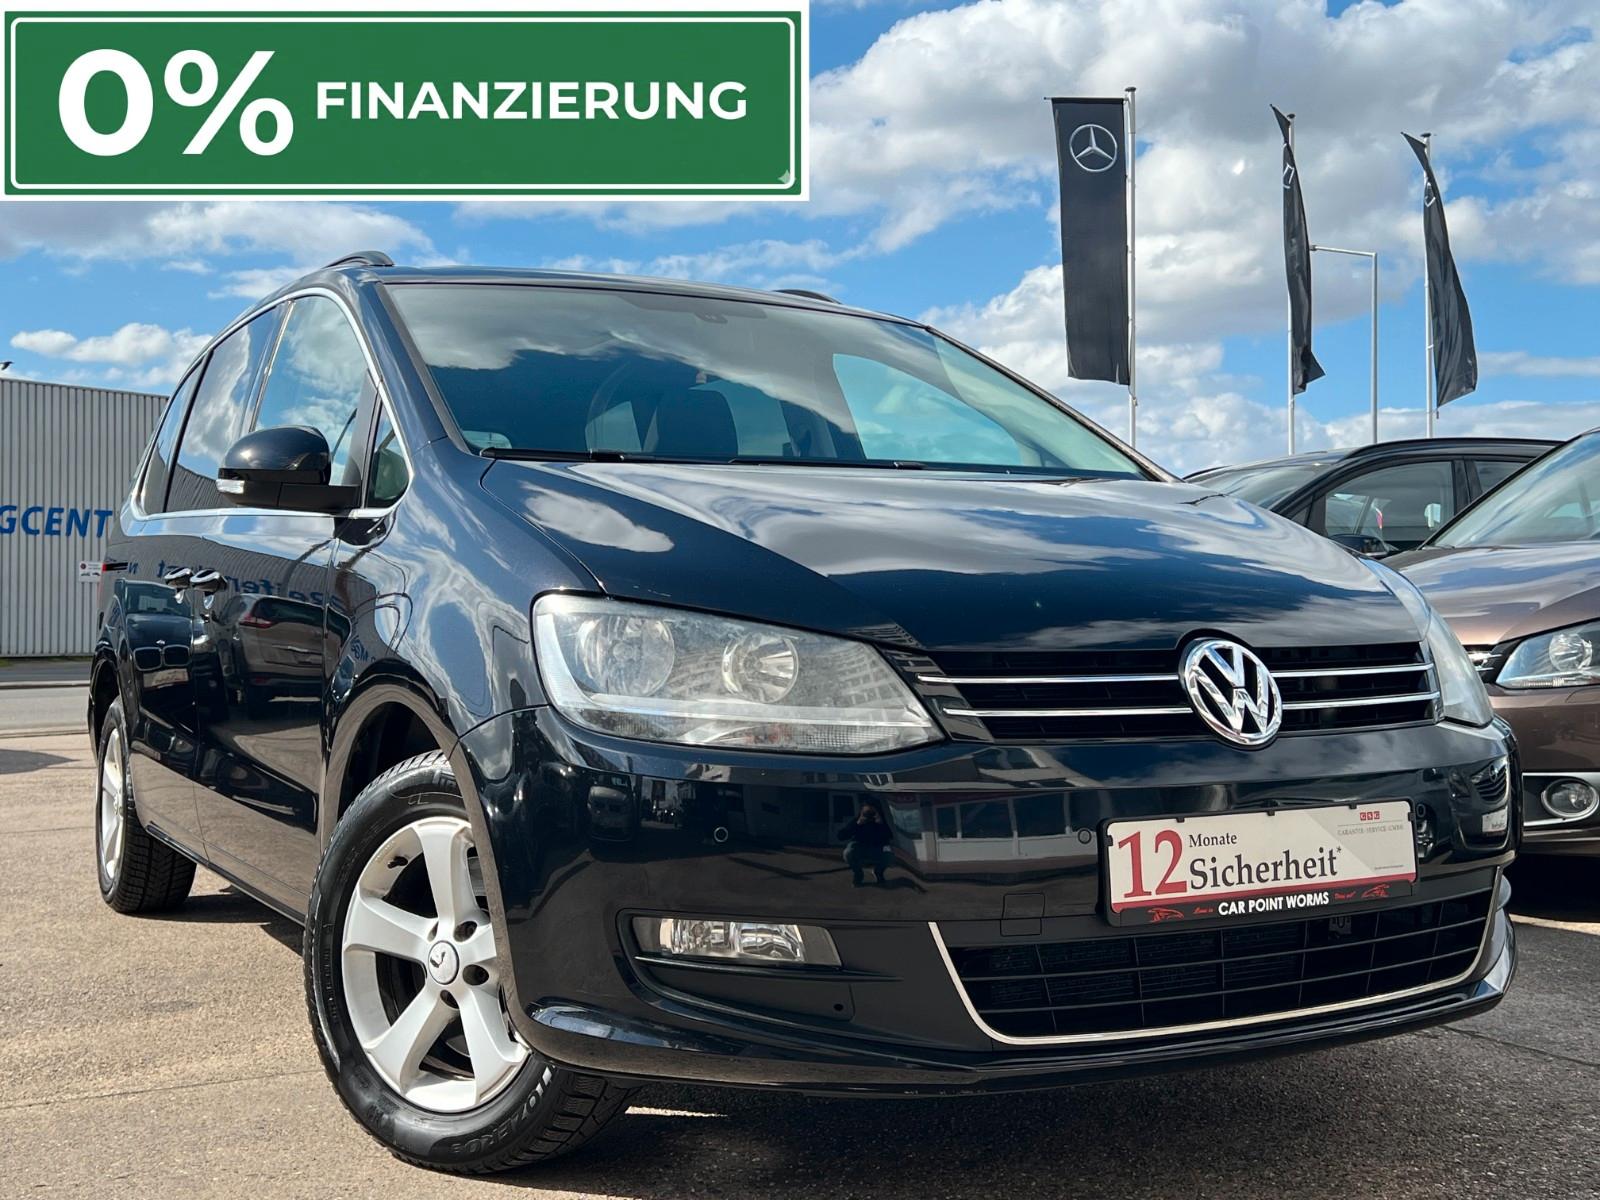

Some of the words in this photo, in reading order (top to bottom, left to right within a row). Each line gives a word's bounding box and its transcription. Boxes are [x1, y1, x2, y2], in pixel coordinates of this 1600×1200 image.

[1189, 833, 1237, 848] Monate
[1118, 830, 1187, 898] 12
[1218, 900, 1247, 916] CAR
[1249, 896, 1285, 912] POINT
[1286, 891, 1329, 909] WORMS
